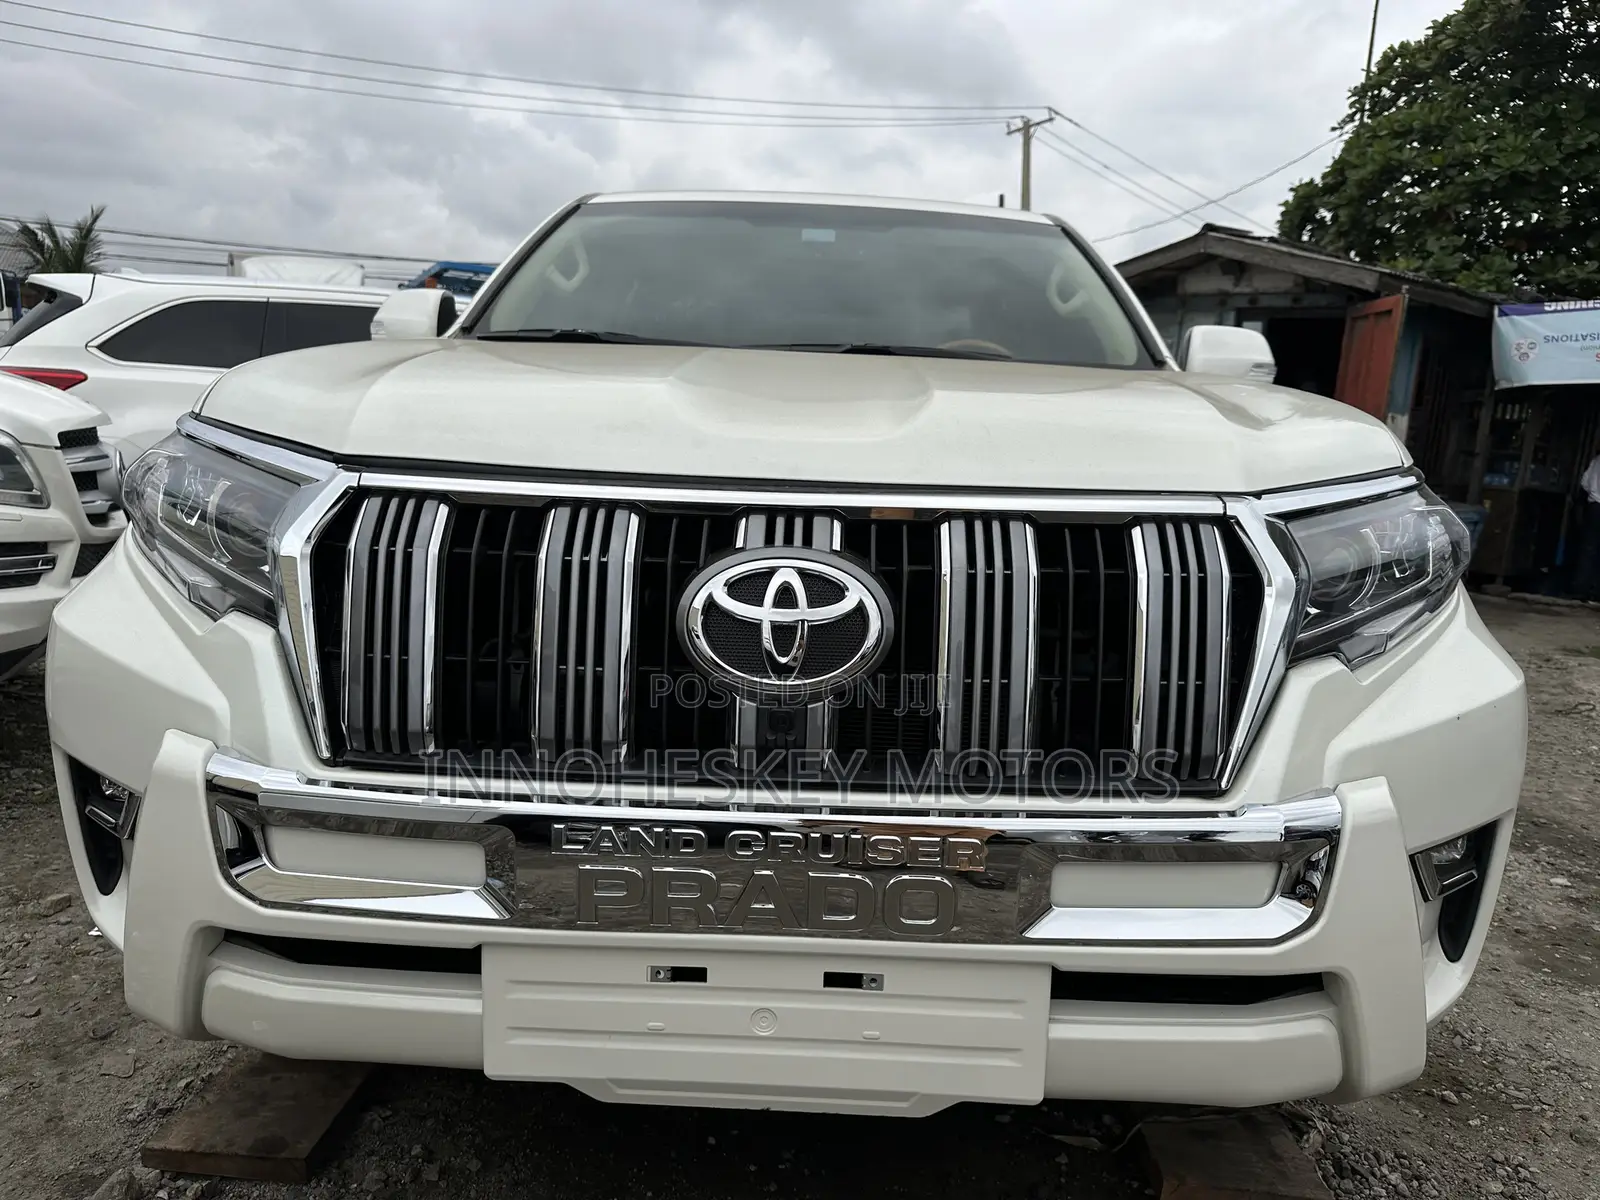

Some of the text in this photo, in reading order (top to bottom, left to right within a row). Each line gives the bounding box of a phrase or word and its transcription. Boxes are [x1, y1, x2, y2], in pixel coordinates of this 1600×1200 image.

[551, 824, 988, 872] LAND CRUISER
[577, 864, 957, 936] PRADO
